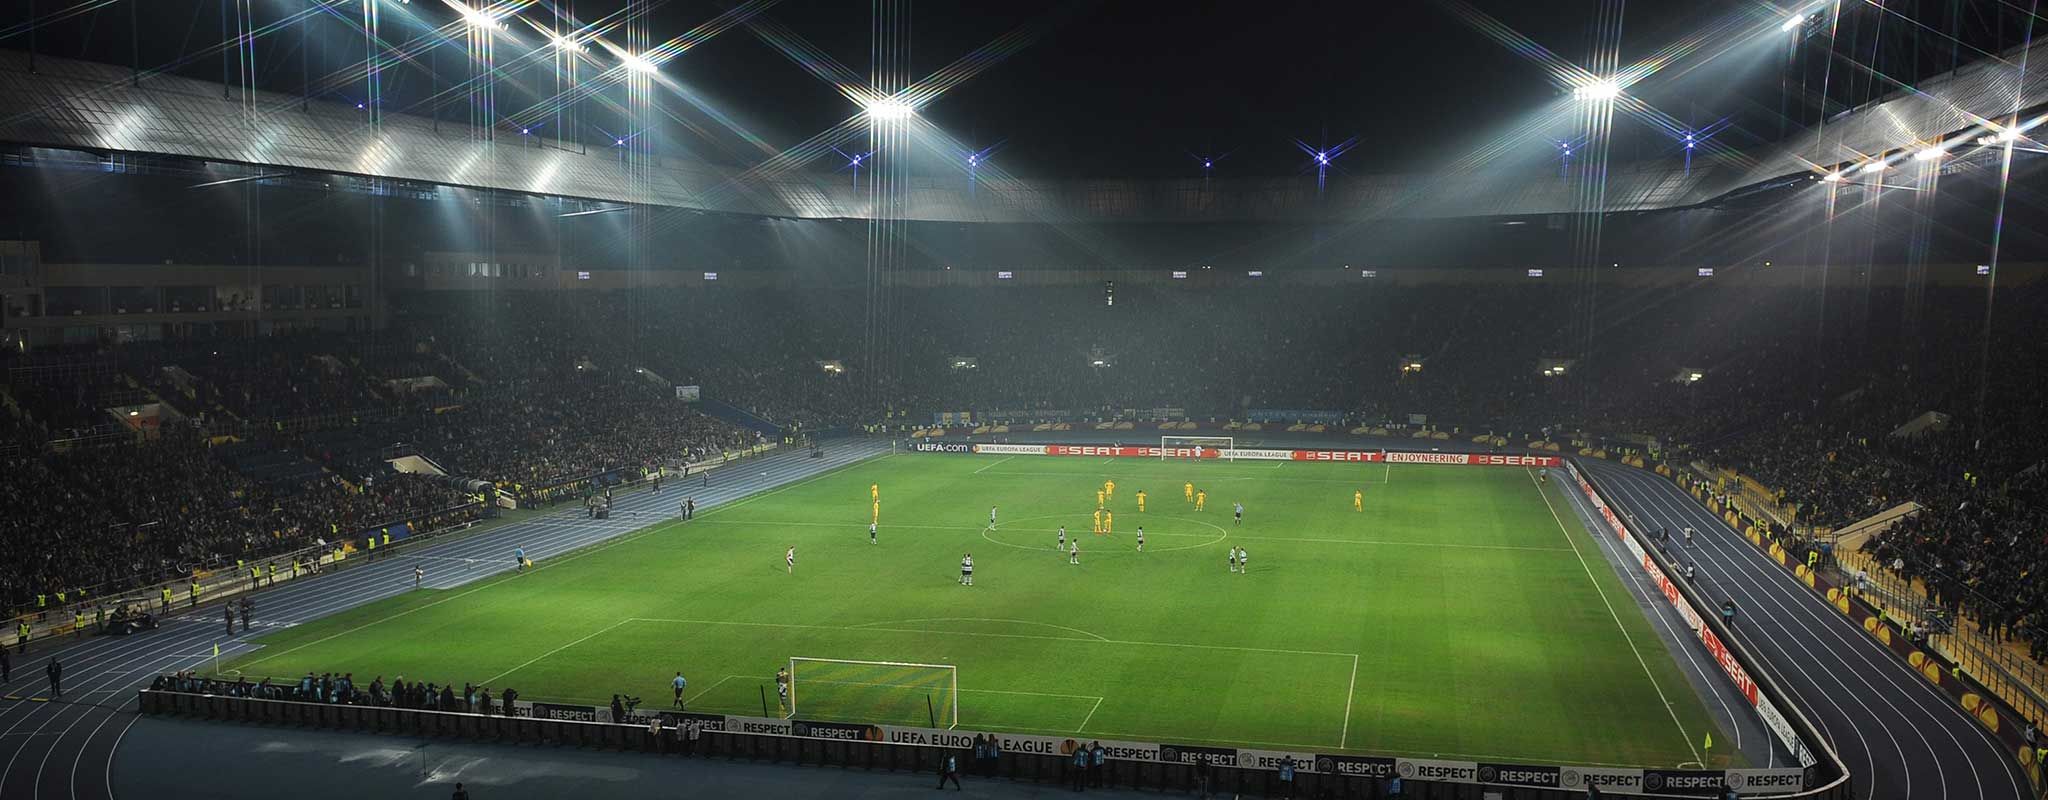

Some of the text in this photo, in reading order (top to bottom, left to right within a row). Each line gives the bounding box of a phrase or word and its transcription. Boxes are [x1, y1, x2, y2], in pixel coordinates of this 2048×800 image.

[981, 445, 996, 453] UEFA
[1069, 446, 1124, 456] SEAT
[1264, 451, 1288, 459] LEAGUE
[1318, 450, 1377, 461] SEAT
[1391, 453, 1463, 463] ENJOYNEERING
[1489, 455, 1552, 465] SEAT
[1724, 655, 1752, 696] SEAT
[549, 709, 594, 720] RESPECT
[743, 723, 791, 735] RESPECT
[810, 727, 860, 740] RESPECT
[891, 731, 927, 744] UEFA
[932, 734, 976, 748] EURO
[1106, 746, 1158, 760] RESPECT
[1258, 756, 1314, 770] RESECT
[1418, 765, 1476, 780] RESPECT
[1500, 770, 1558, 785] RESPECT
[1583, 773, 1642, 787] RESPECT
[1666, 776, 1723, 788] RESPECT
[1746, 773, 1802, 787] RESPECT
